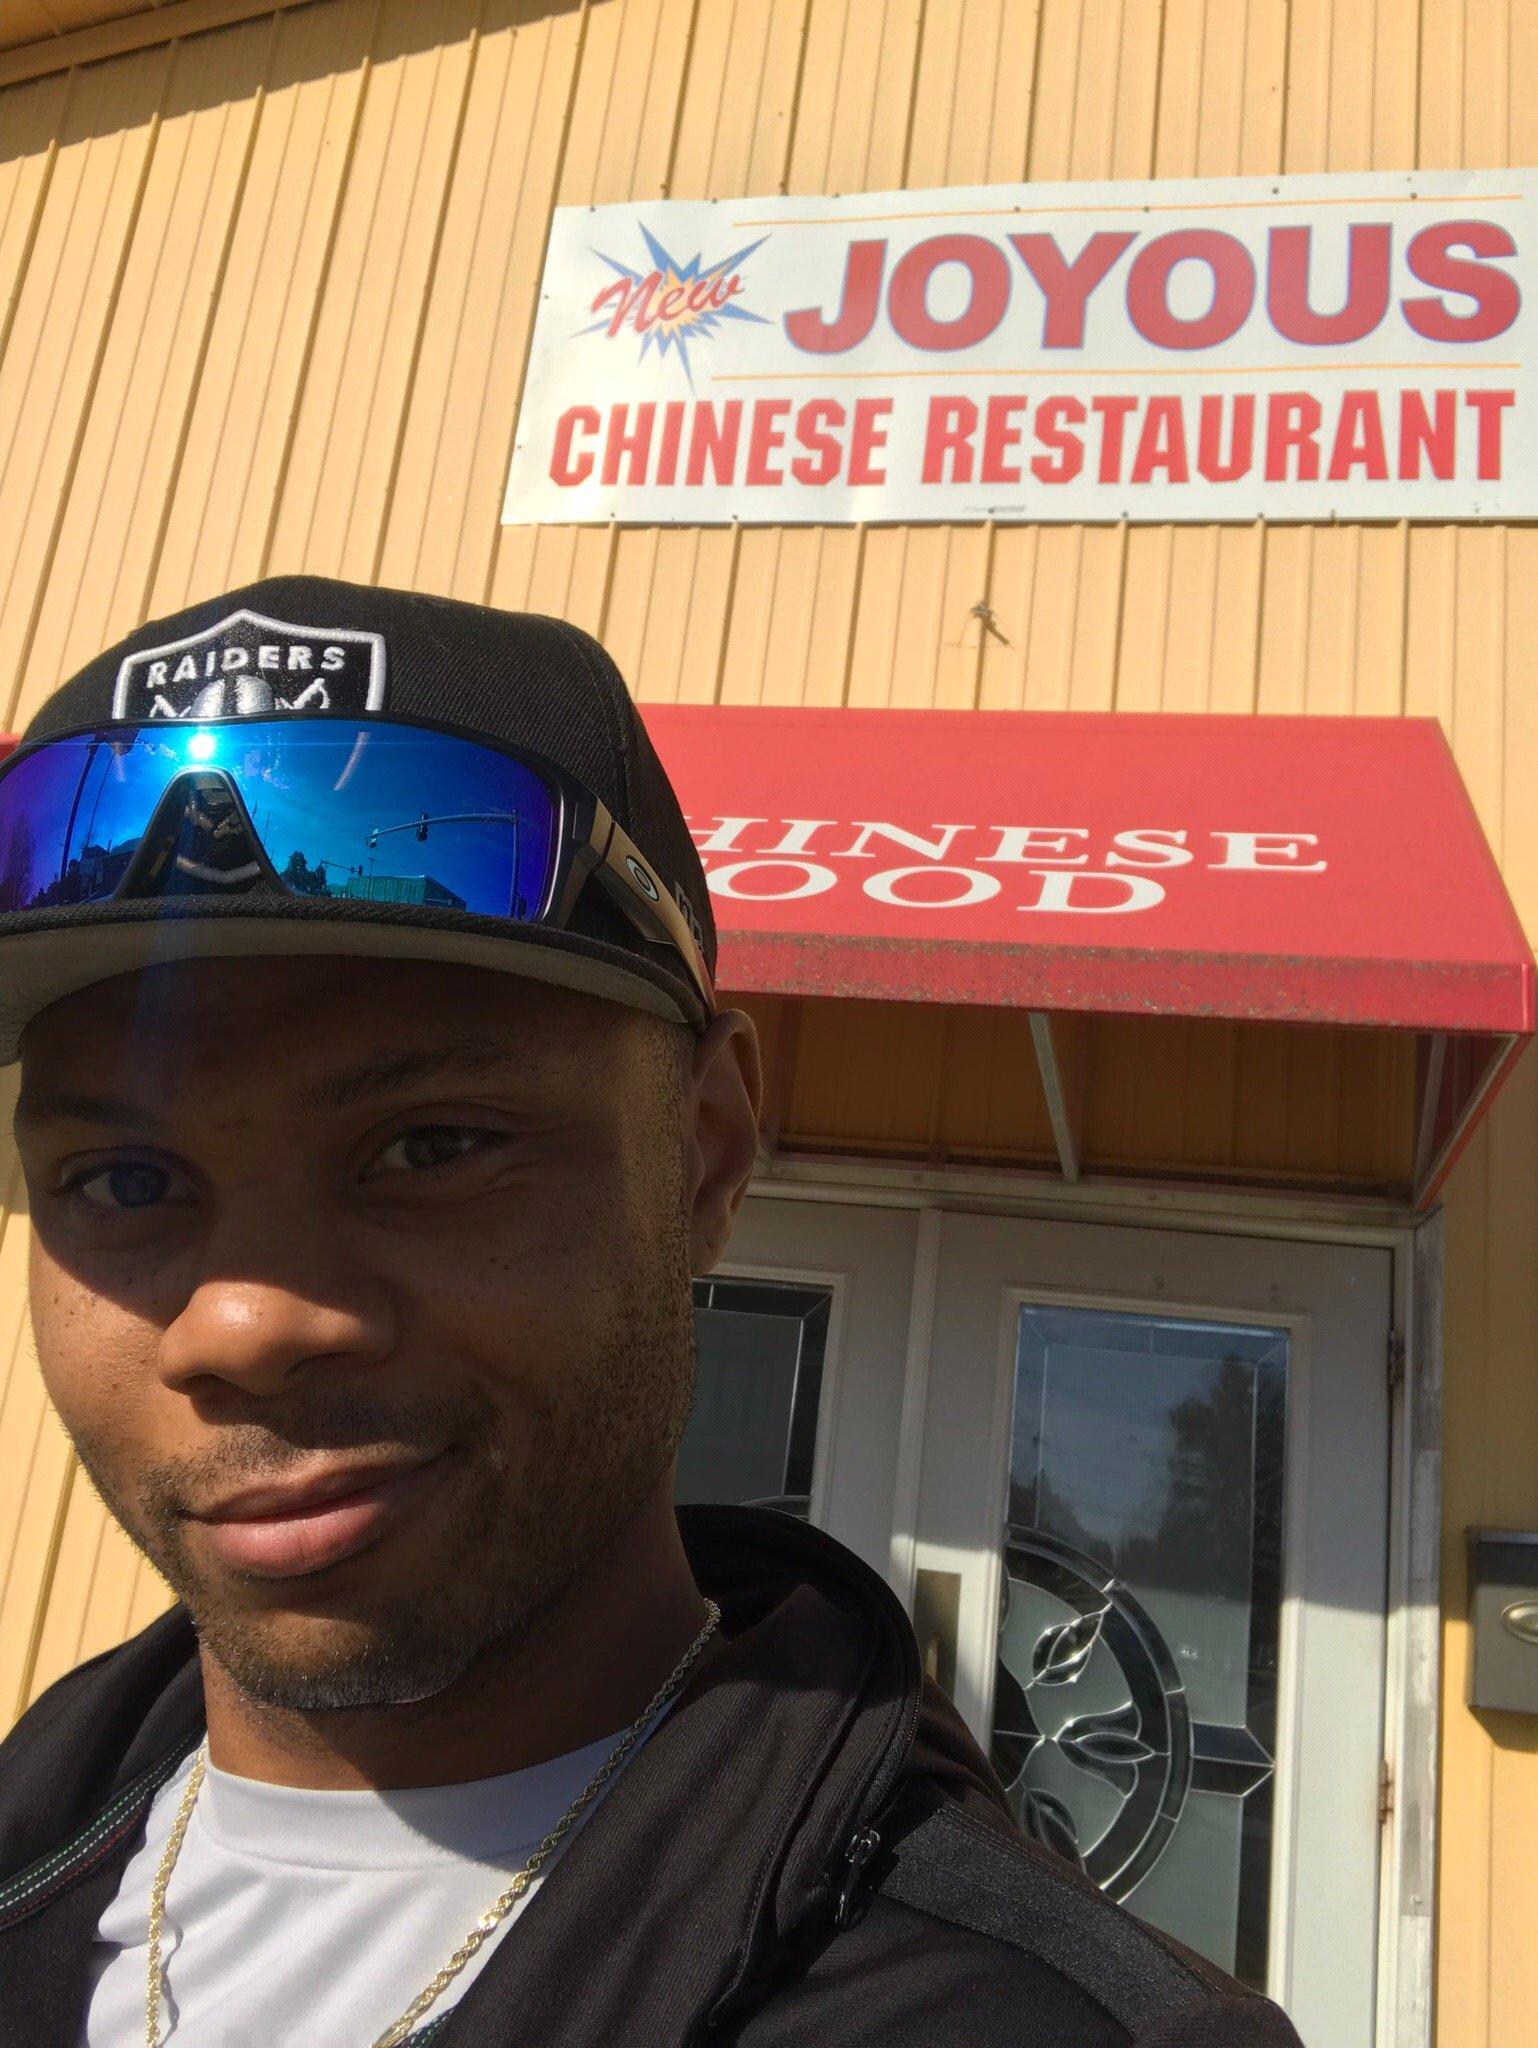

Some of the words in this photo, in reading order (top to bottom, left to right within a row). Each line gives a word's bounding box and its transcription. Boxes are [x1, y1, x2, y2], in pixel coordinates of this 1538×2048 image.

[590, 270, 745, 338] New
[785, 221, 1521, 353] JOYOUS
[548, 397, 893, 488] CHINESE
[921, 389, 1516, 486] RESTAURANT
[146, 645, 346, 689] RAIDERS
[684, 815, 1328, 873] HINESE
[700, 857, 1166, 914] OOD
